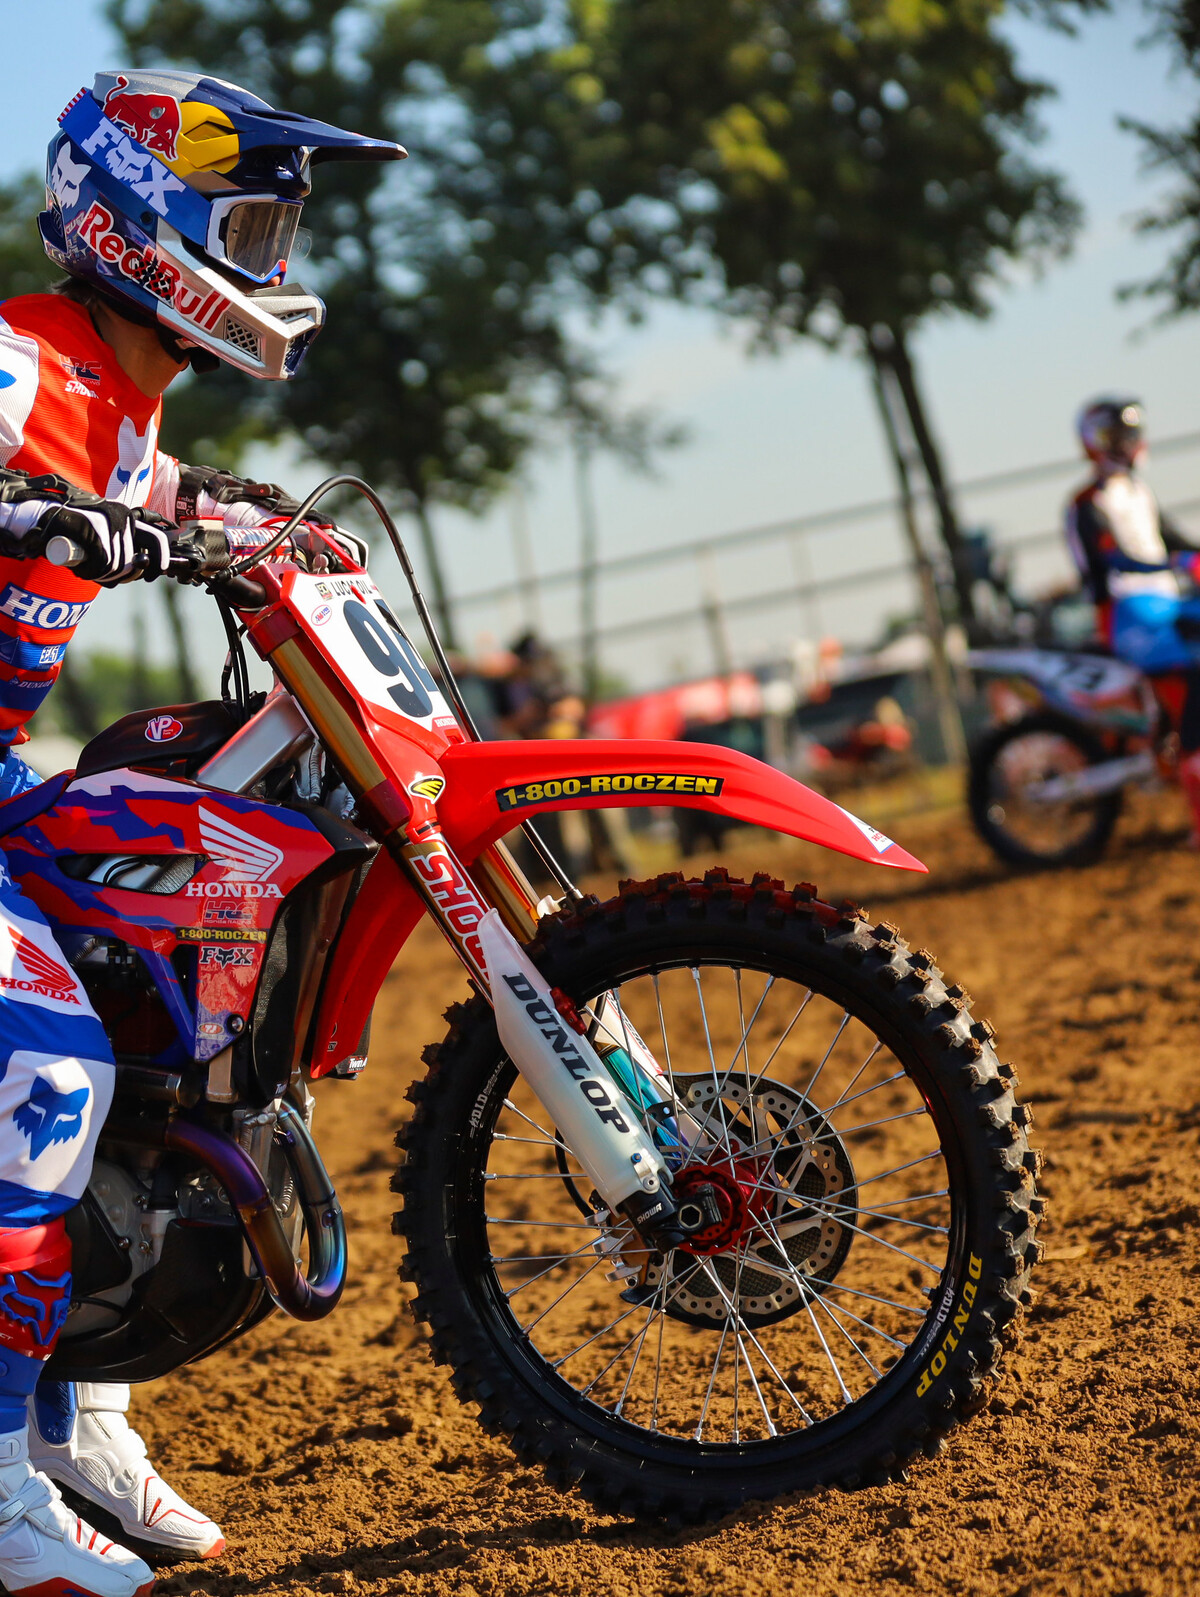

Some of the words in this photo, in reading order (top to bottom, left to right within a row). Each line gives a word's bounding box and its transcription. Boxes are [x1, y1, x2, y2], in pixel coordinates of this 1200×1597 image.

[77, 200, 158, 284] Red
[144, 258, 232, 333] Bull
[503, 774, 718, 806] 1-800-ROCZEN
[185, 882, 285, 898] HONDA
[408, 851, 490, 985] SHO
[180, 929, 267, 941] 1-800-ROCZEN
[0, 977, 82, 1006] HONDA
[502, 972, 631, 1134] DUNLOP
[636, 1202, 663, 1225] SHOWA
[916, 1251, 983, 1398] DUNLOP
